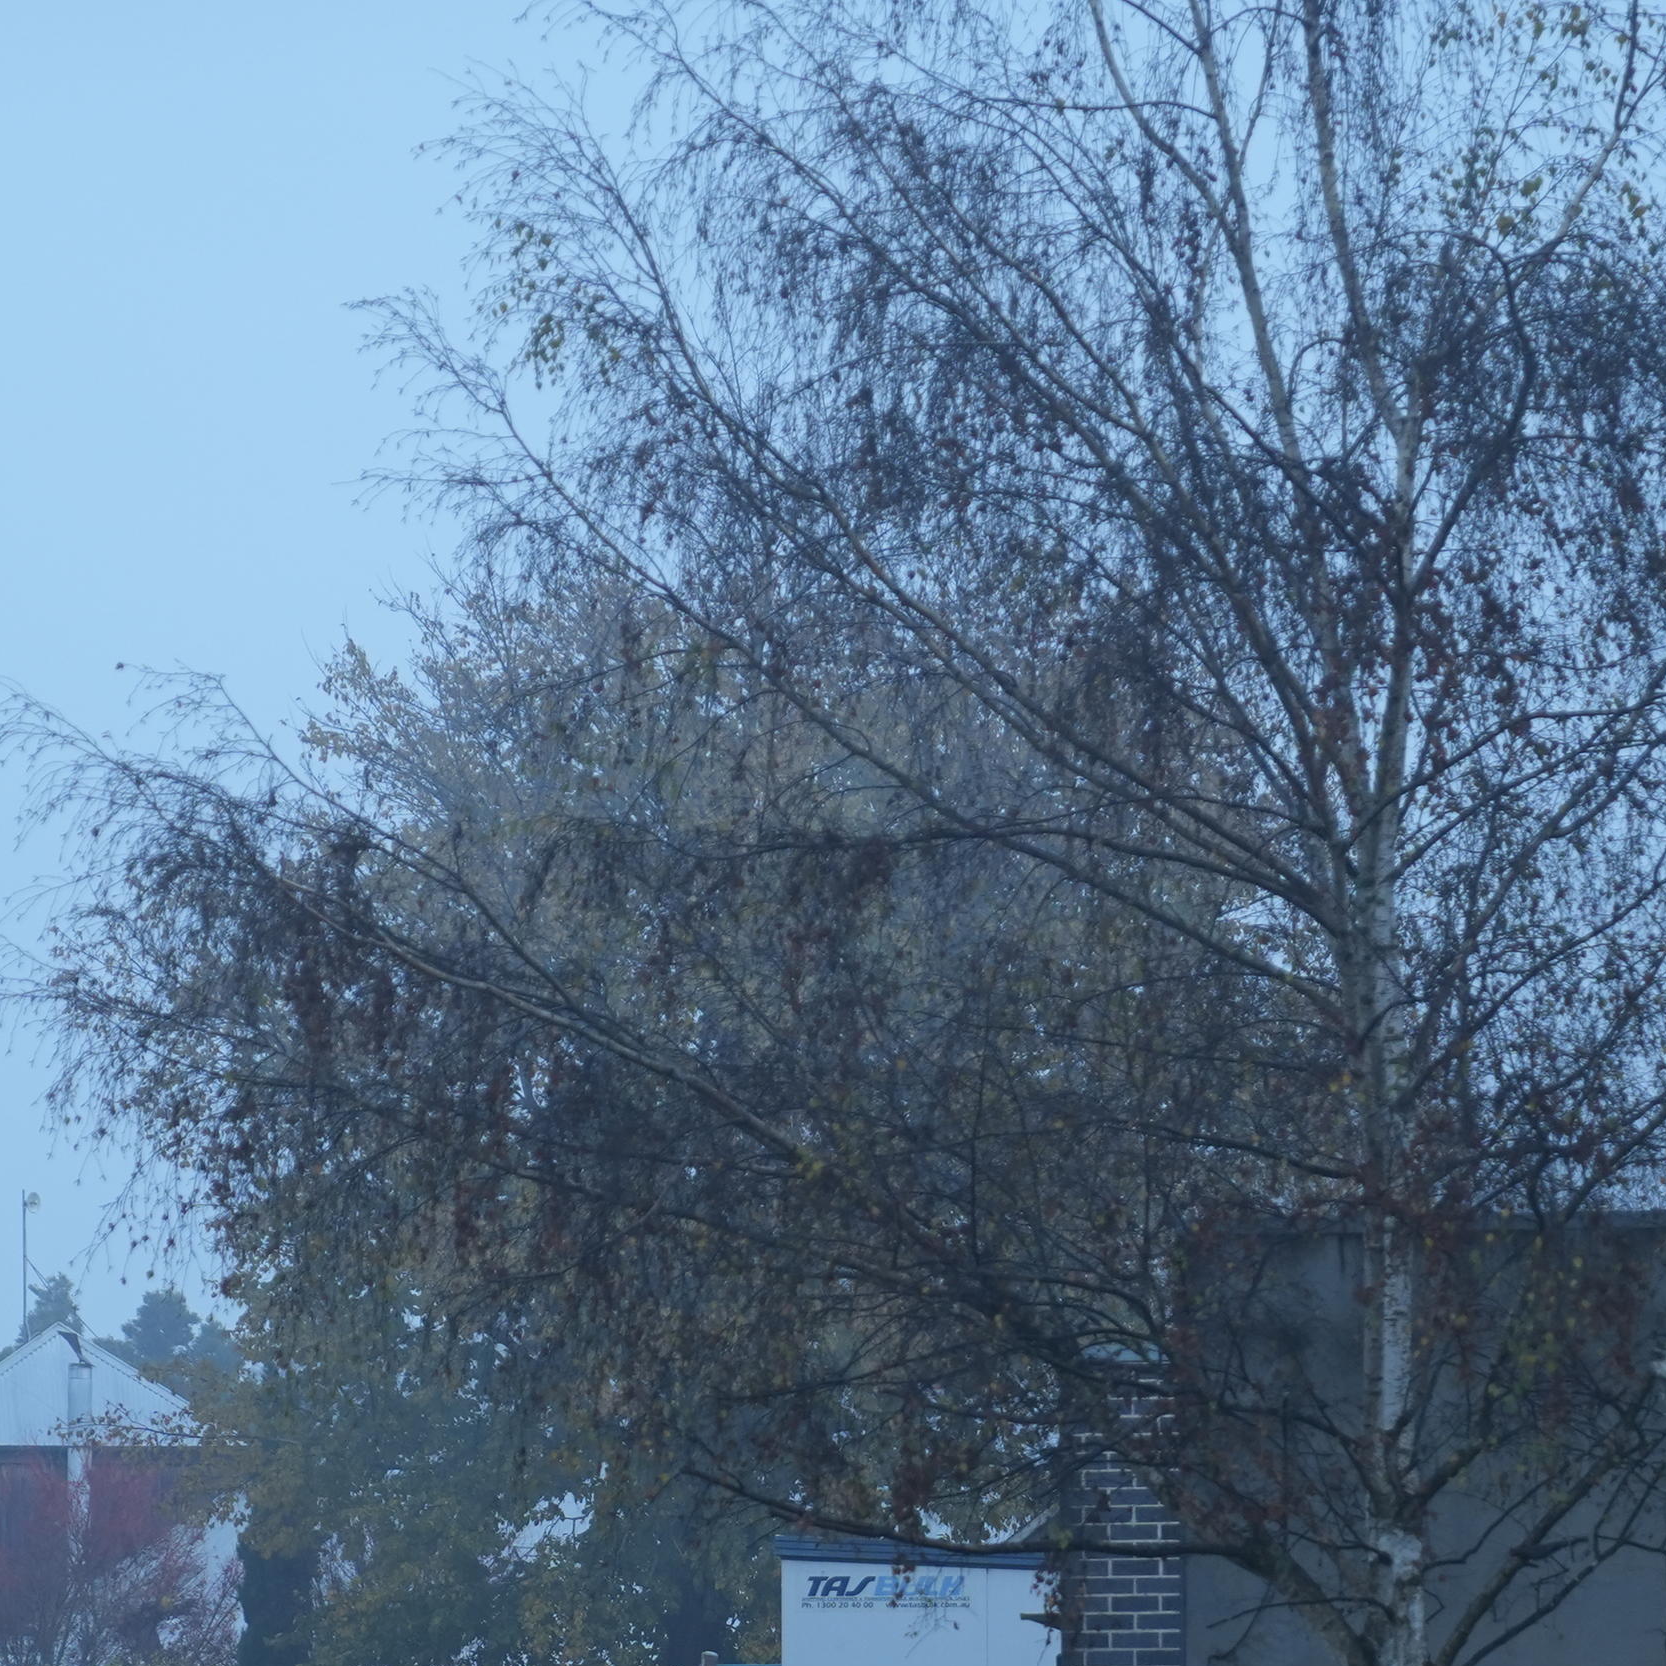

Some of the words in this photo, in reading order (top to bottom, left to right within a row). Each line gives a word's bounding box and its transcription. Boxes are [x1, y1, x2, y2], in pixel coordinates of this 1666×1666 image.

[807, 1576, 965, 1596] TASBULK
[801, 1601, 814, 1609] Ph.
[817, 1601, 837, 1609] 1300
[838, 1601, 849, 1609] 20
[851, 1601, 862, 1609] 40
[863, 1601, 874, 1609] 00
